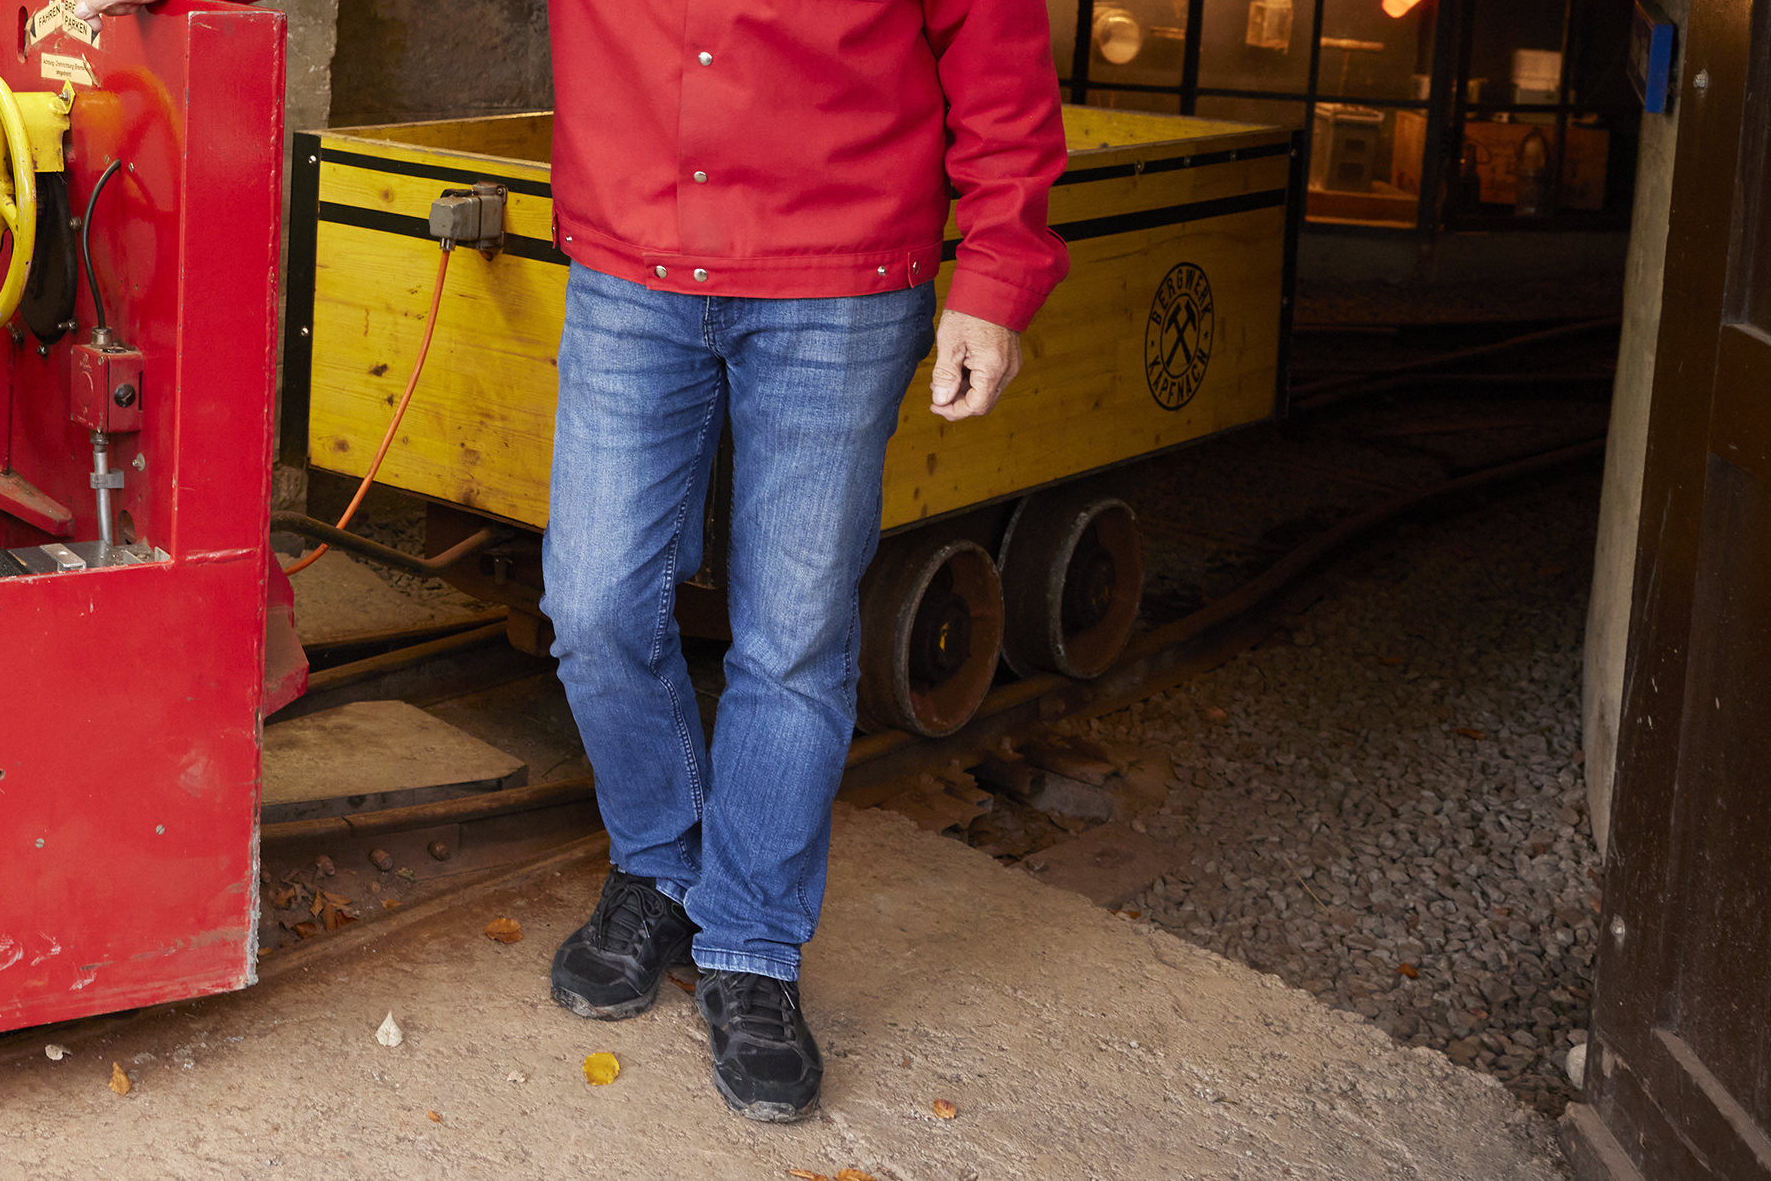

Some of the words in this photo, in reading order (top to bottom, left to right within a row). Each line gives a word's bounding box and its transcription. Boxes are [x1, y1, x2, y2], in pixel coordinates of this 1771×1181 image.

[38, 3, 61, 28] FAHREN
[64, 15, 88, 36] PARKEN
[1151, 268, 1212, 326] BERGWERK
